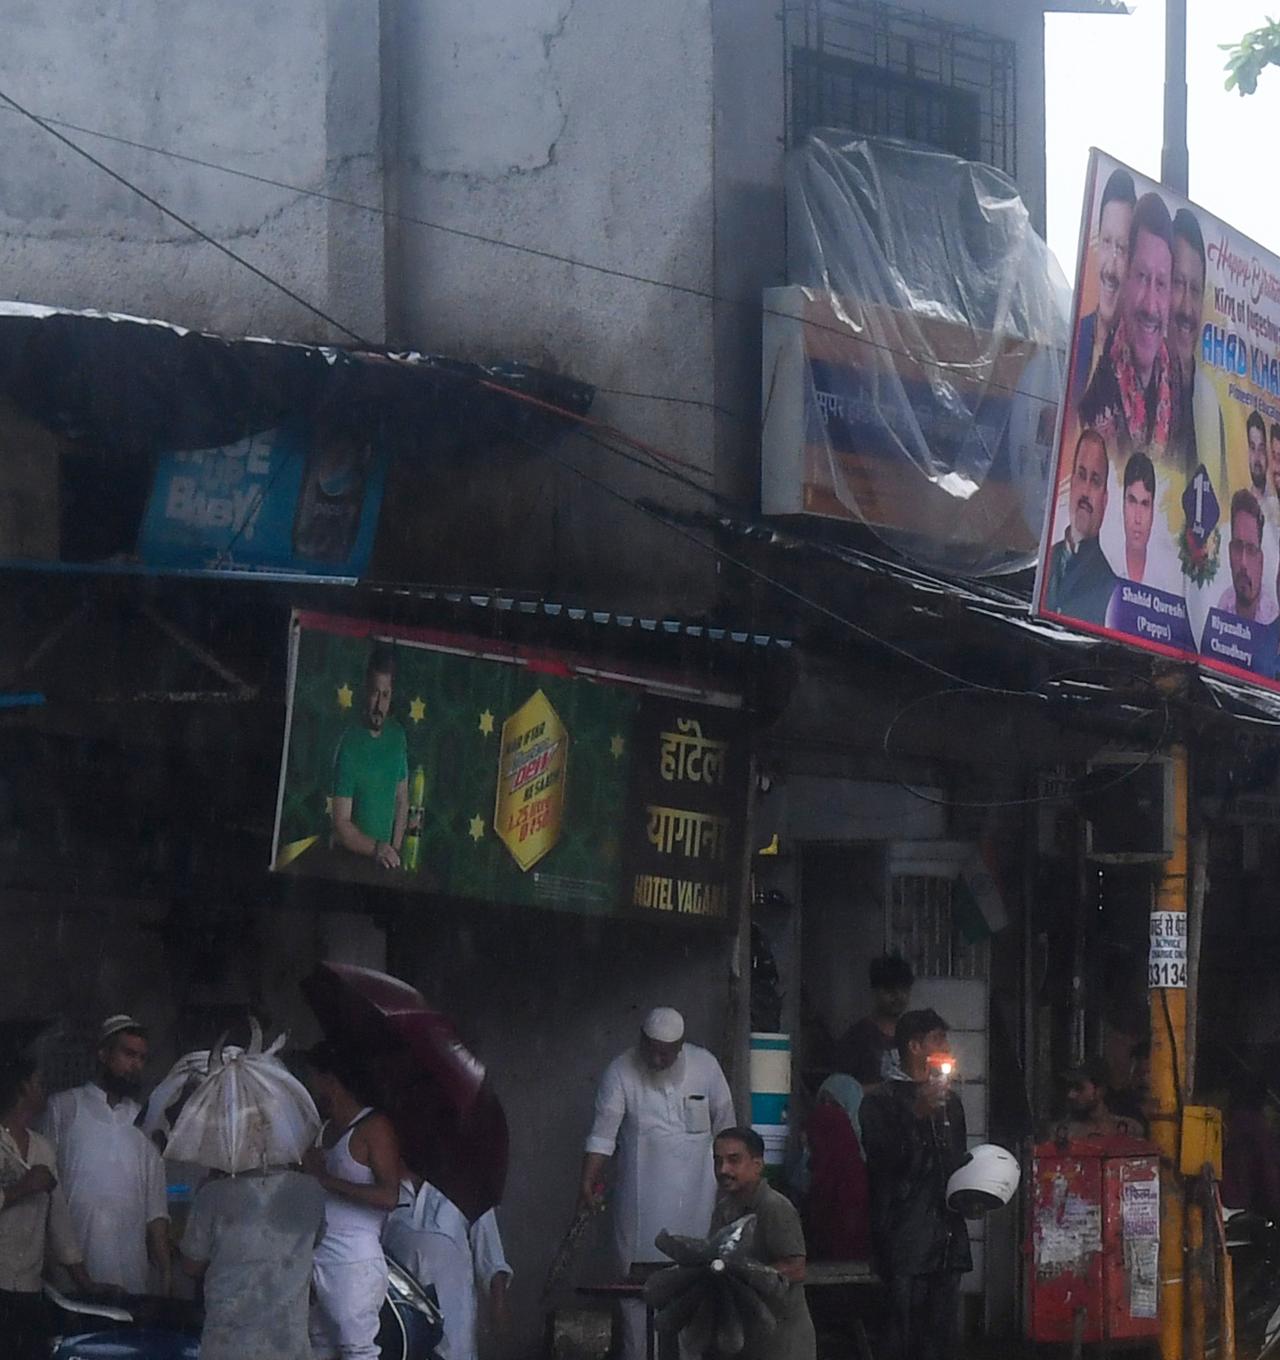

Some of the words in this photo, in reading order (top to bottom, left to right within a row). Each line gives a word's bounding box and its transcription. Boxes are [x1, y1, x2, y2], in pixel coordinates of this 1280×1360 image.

[1201, 322, 1247, 377] AHAD
[1122, 586, 1152, 609] Shahid
[1153, 597, 1186, 620] Qureshi
[1137, 614, 1171, 642] (Pappu)
[1211, 637, 1252, 667] Chaudhary
[633, 874, 673, 912] HOTEL
